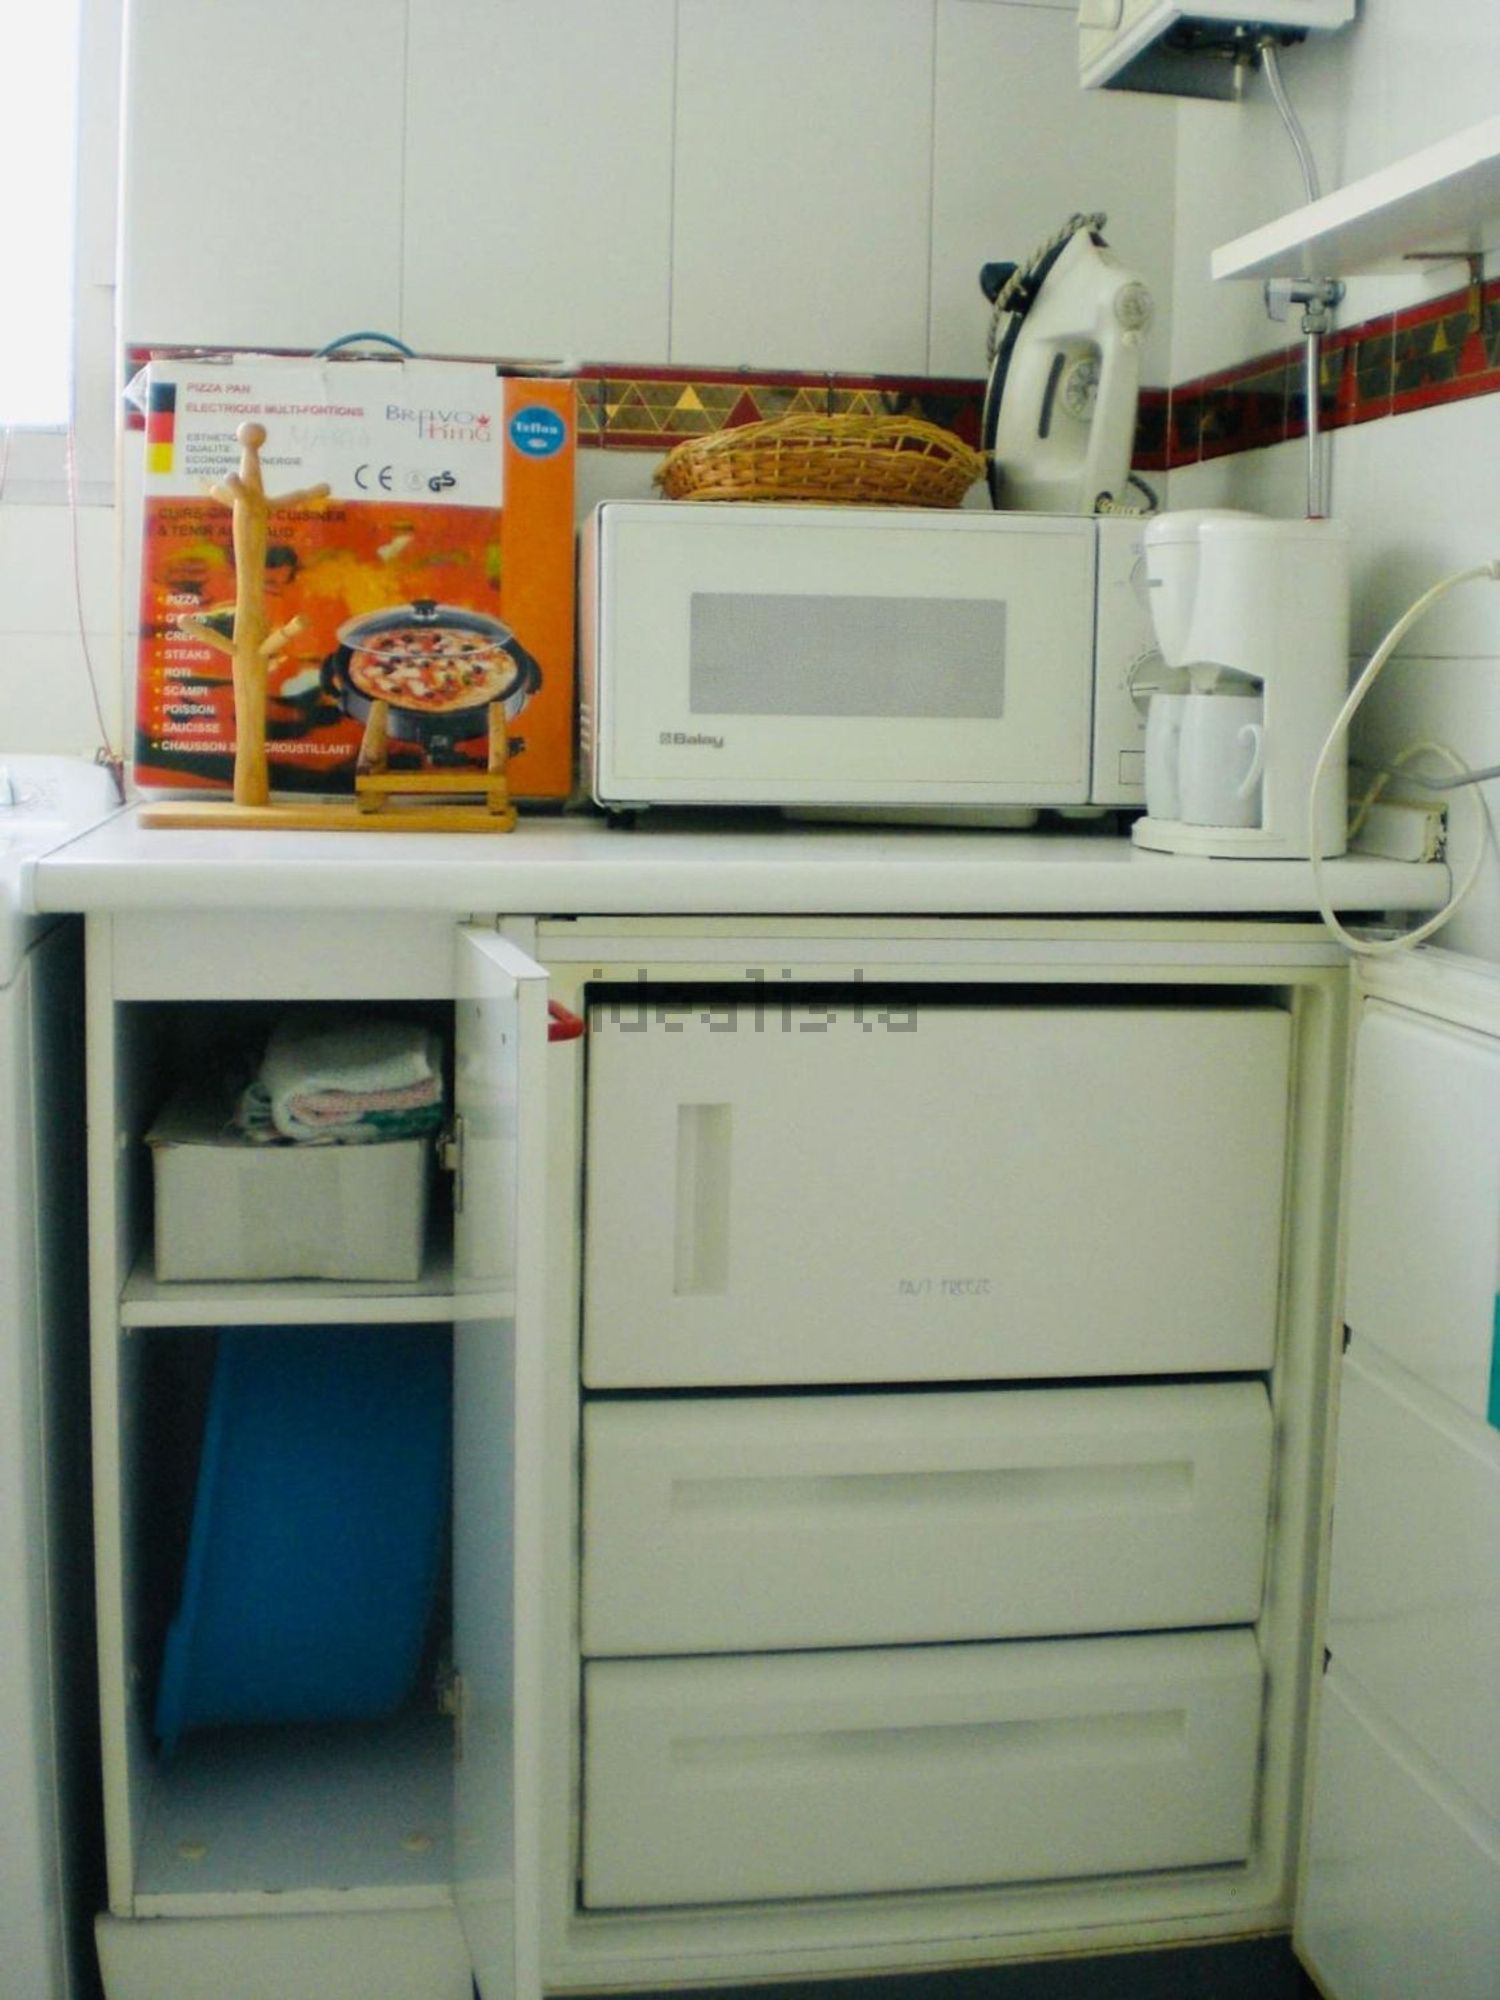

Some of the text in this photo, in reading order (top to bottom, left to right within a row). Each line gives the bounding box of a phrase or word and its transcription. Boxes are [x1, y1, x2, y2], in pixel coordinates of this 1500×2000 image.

[186, 383, 251, 394] PIZZA PAN
[186, 403, 261, 415] ELECTRIQUE
[164, 649, 211, 661] STEAKS
[163, 704, 215, 715] POISSON
[161, 739, 227, 752] CHAUSSON
